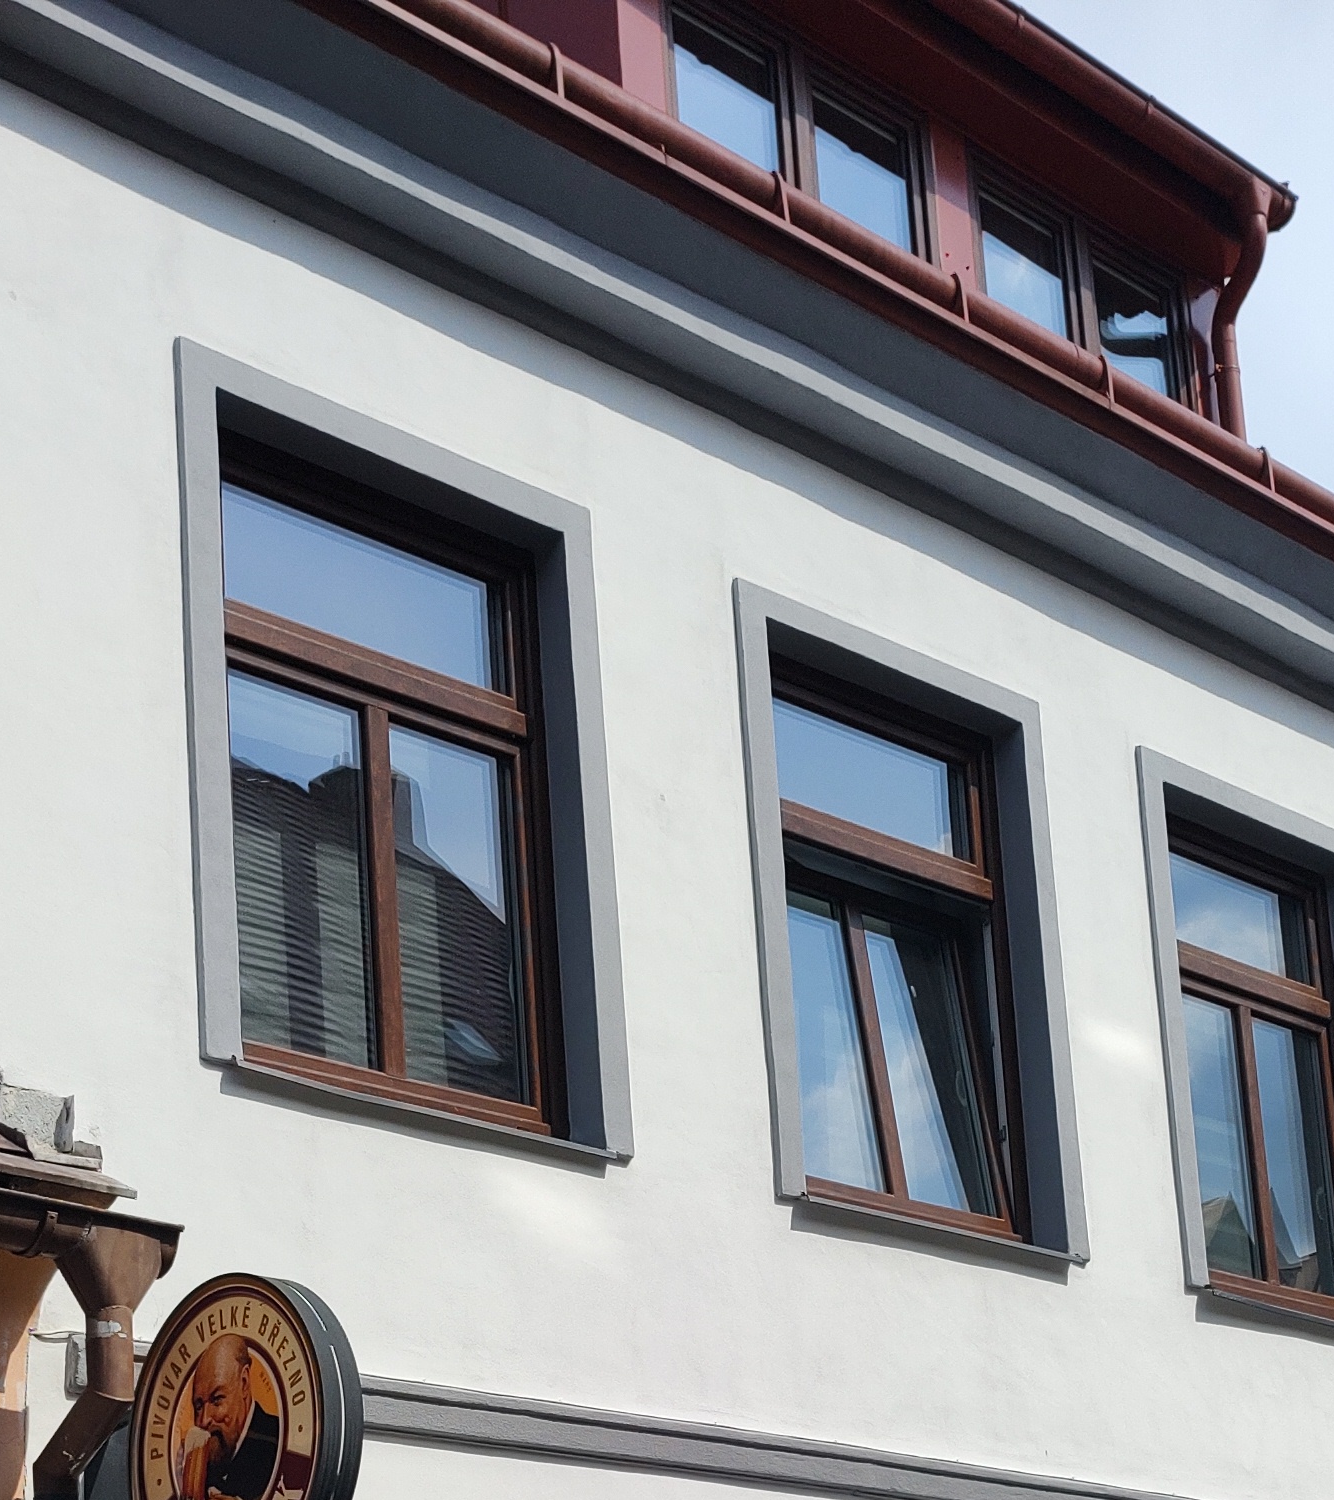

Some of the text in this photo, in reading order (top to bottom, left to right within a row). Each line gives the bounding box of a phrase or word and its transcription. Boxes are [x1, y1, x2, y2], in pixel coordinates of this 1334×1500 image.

[150, 1301, 306, 1460] PIVOVAR VELKÉ BŘEZNO
